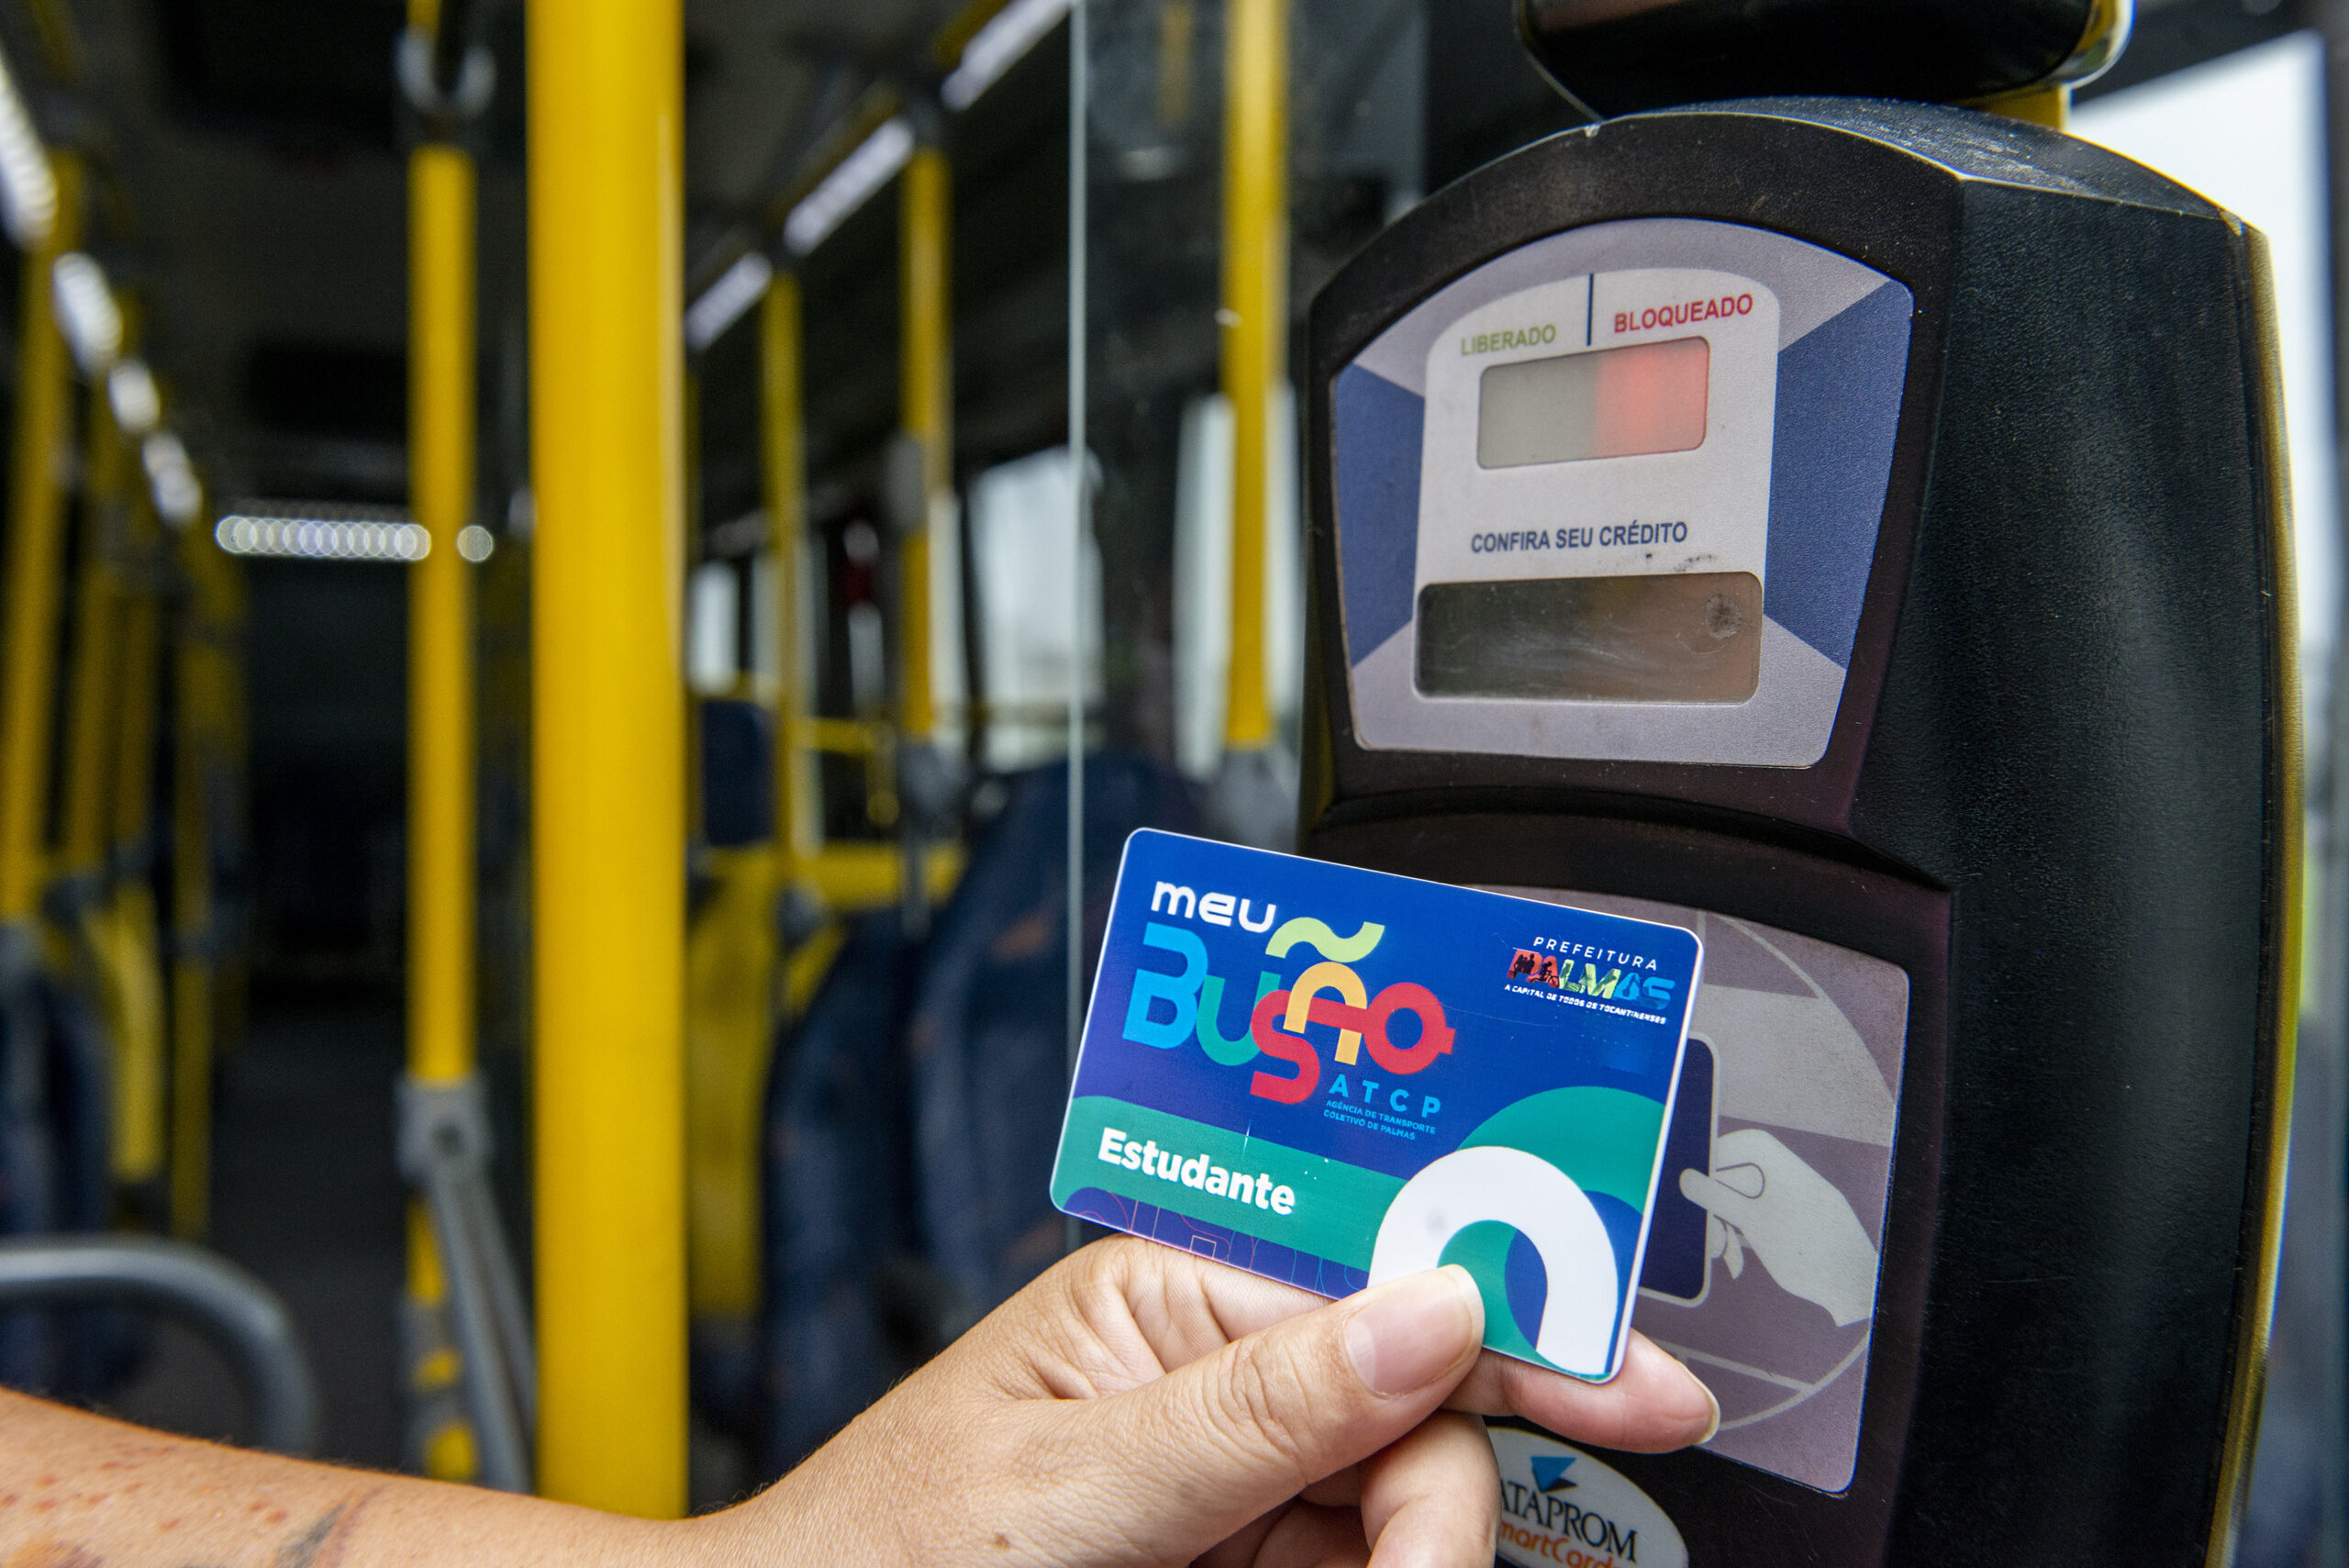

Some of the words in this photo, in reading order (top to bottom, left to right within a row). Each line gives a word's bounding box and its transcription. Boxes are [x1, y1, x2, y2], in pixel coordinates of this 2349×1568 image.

[1613, 293, 1754, 333] BLOQUEADO
[1461, 324, 1557, 356] LIBERADO
[1471, 530, 1550, 552] CONFIRA
[1555, 528, 1593, 549] SEU
[1599, 519, 1687, 546] CRÉDITO
[1533, 937, 1657, 971] PREFEITURA
[1507, 949, 1676, 1010] PALMAS
[1511, 984, 1544, 999] CAPITAL
[1546, 993, 1557, 1001] DE
[1559, 995, 1585, 1007] TODOS
[1586, 1001, 1598, 1009] OS
[1599, 1003, 1666, 1025] TOCANTINENSES
[1323, 1109, 1365, 1127] COLETIVO
[1367, 1120, 1378, 1130] DE
[1380, 1125, 1416, 1140] PALMAS
[1326, 1100, 1363, 1116] AGÊNCIA
[1364, 1109, 1376, 1118] DE
[1378, 1113, 1436, 1135] TRANSPORTE
[1097, 1127, 1296, 1215] Estudante
[1500, 1479, 1638, 1563] TAPROM
